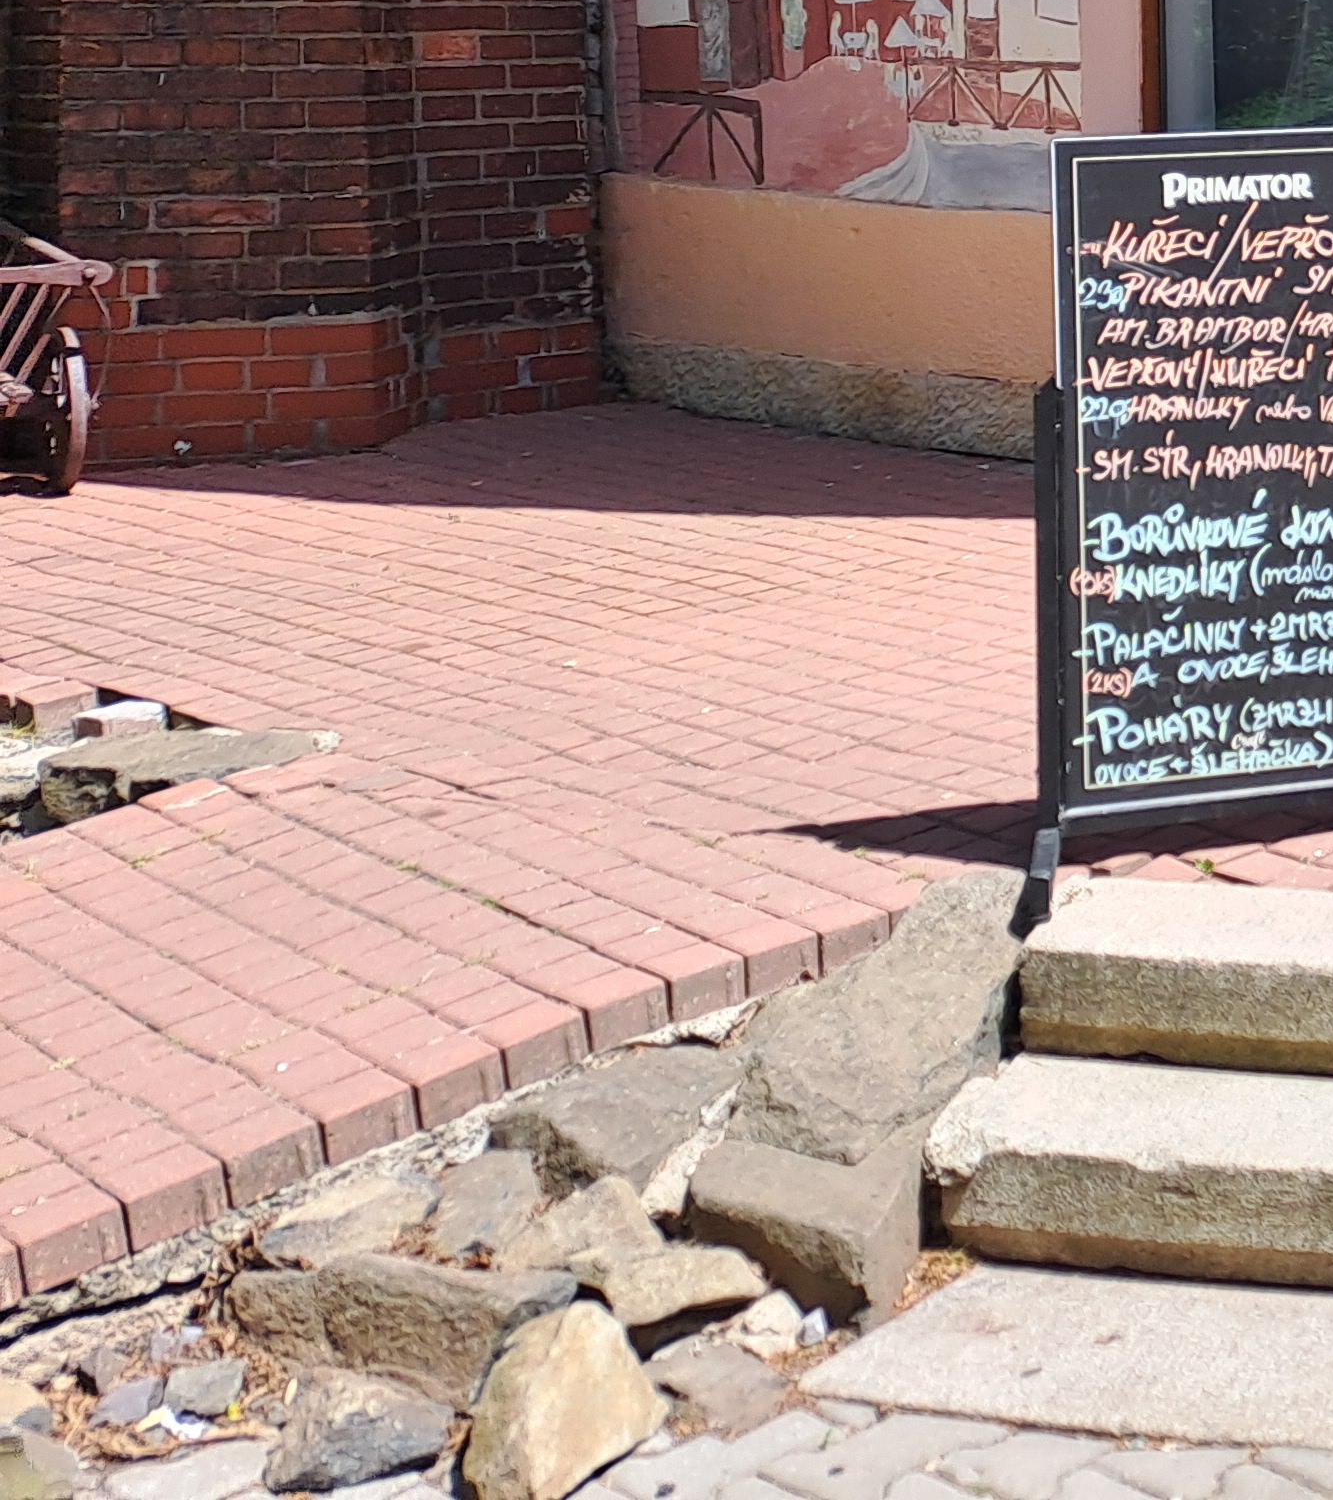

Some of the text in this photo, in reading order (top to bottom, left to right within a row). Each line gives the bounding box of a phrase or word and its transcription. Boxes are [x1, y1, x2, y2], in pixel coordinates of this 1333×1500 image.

[1162, 172, 1314, 208] PRIMATOR
[1118, 267, 1283, 308] PIKANTNÍ
[1255, 393, 1312, 423] nebo
